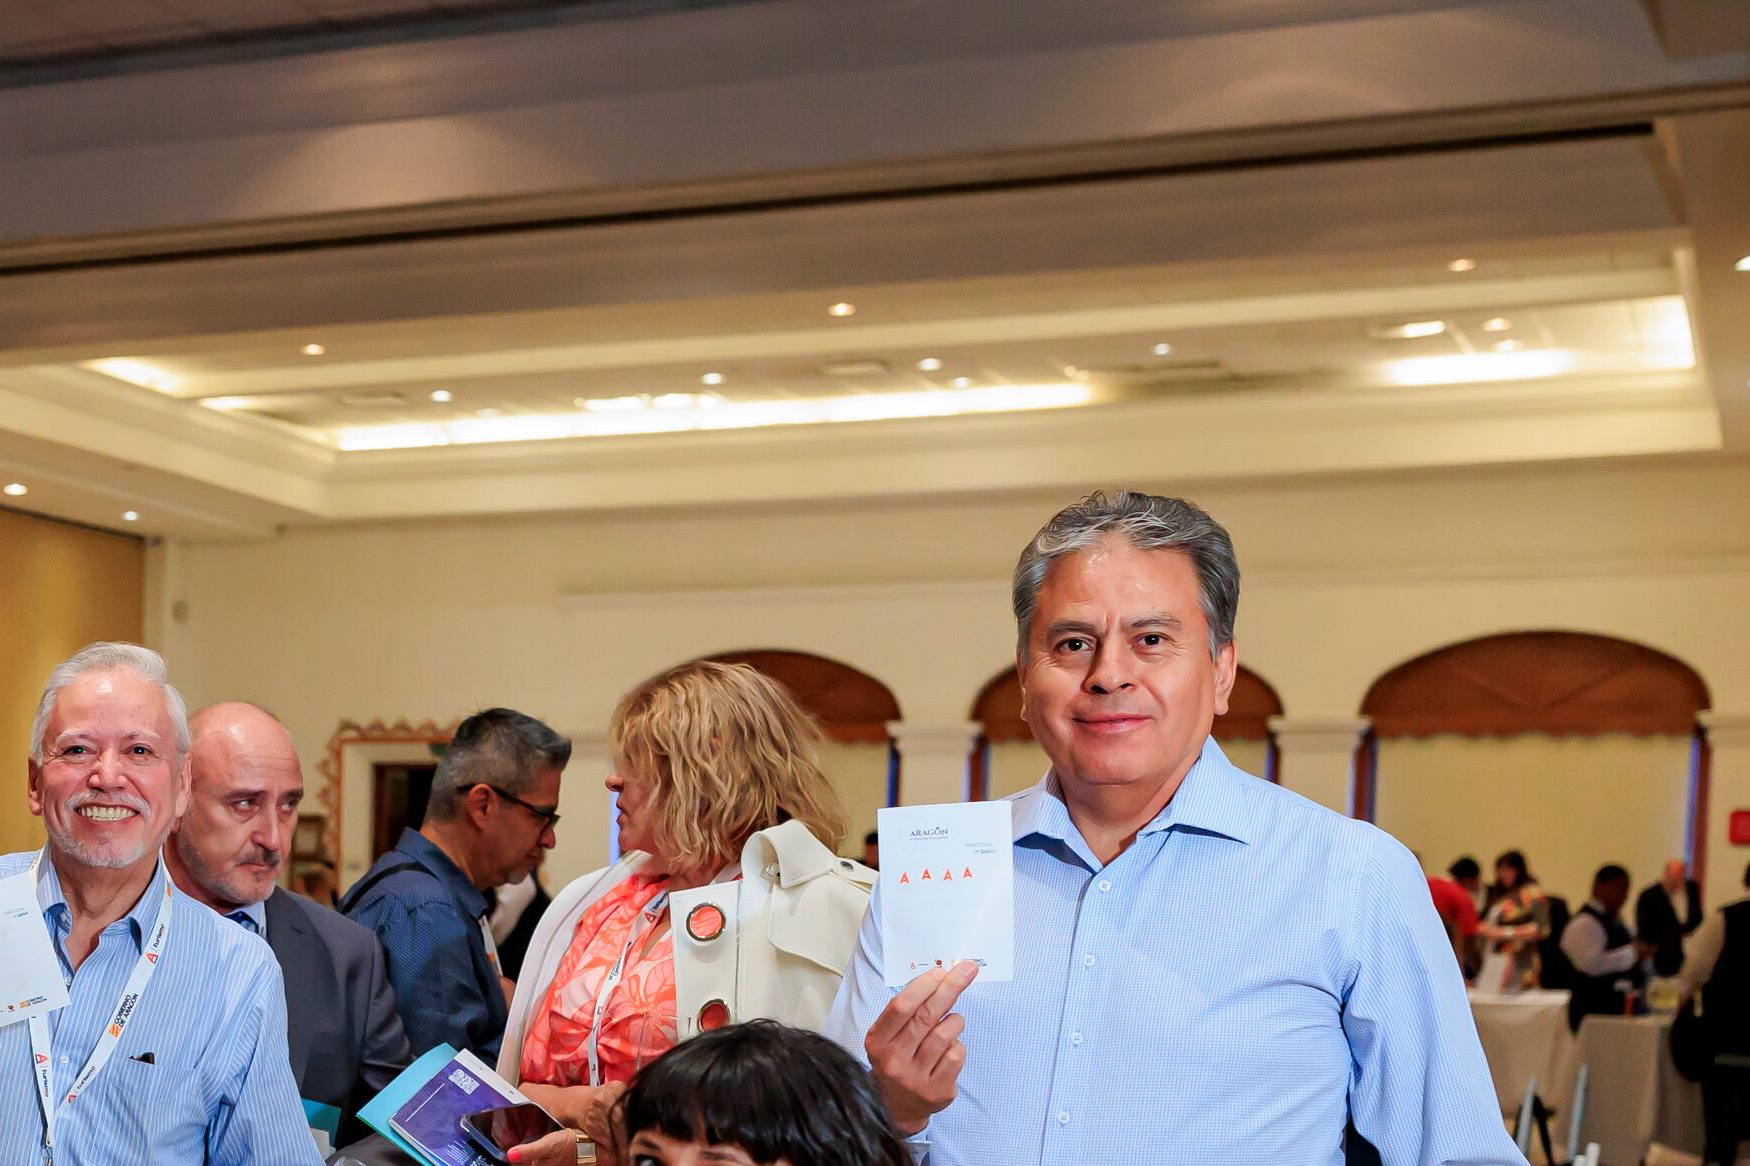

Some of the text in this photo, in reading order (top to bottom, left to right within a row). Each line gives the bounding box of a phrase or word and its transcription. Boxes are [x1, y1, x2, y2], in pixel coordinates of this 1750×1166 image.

[910, 826, 949, 838] ARAGÓN
[153, 923, 165, 948] turismo
[113, 994, 132, 1024] GOBIERNO
[118, 993, 139, 1028] DE ARAGÓN
[41, 1068, 49, 1098] turismo
